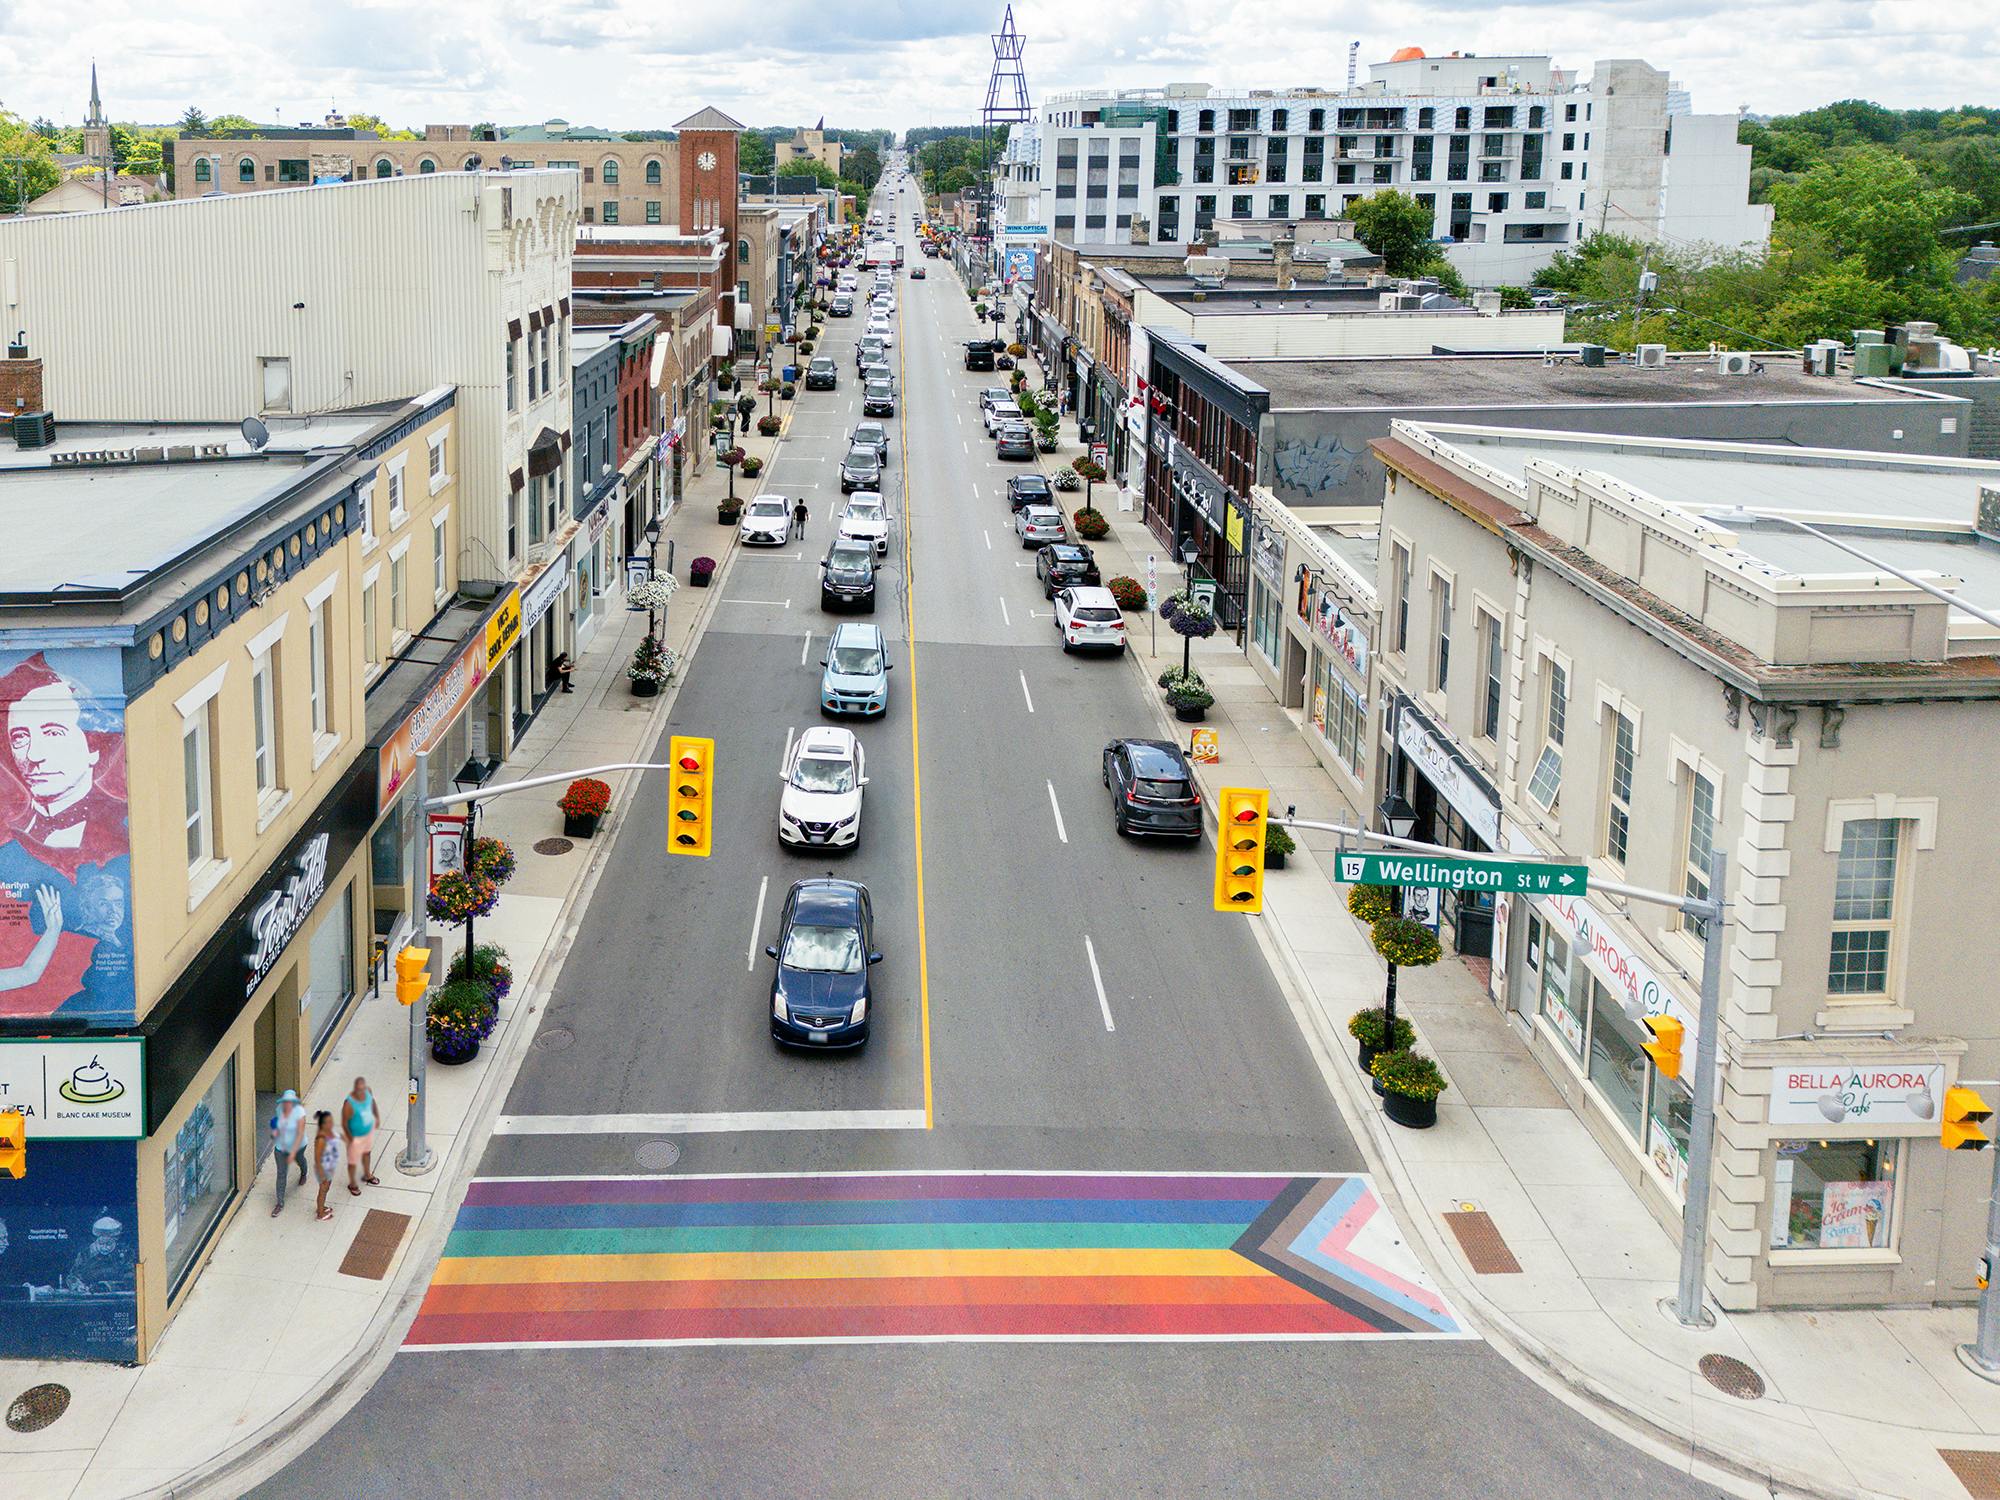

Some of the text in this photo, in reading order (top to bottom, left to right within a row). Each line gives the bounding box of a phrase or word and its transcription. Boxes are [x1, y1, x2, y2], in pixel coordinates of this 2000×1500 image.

[488, 614, 520, 663] SHOE REPAIR
[1346, 861, 1551, 889] 15 Wellington St W
[246, 880, 326, 998] REAL ESTATE INC BROKERAGE
[1580, 918, 1639, 1000] AURORA
[1788, 1073, 1927, 1089] BELLA AURORA
[101, 1111, 132, 1119] MUSEUM
[1841, 1091, 1872, 1117] Café
